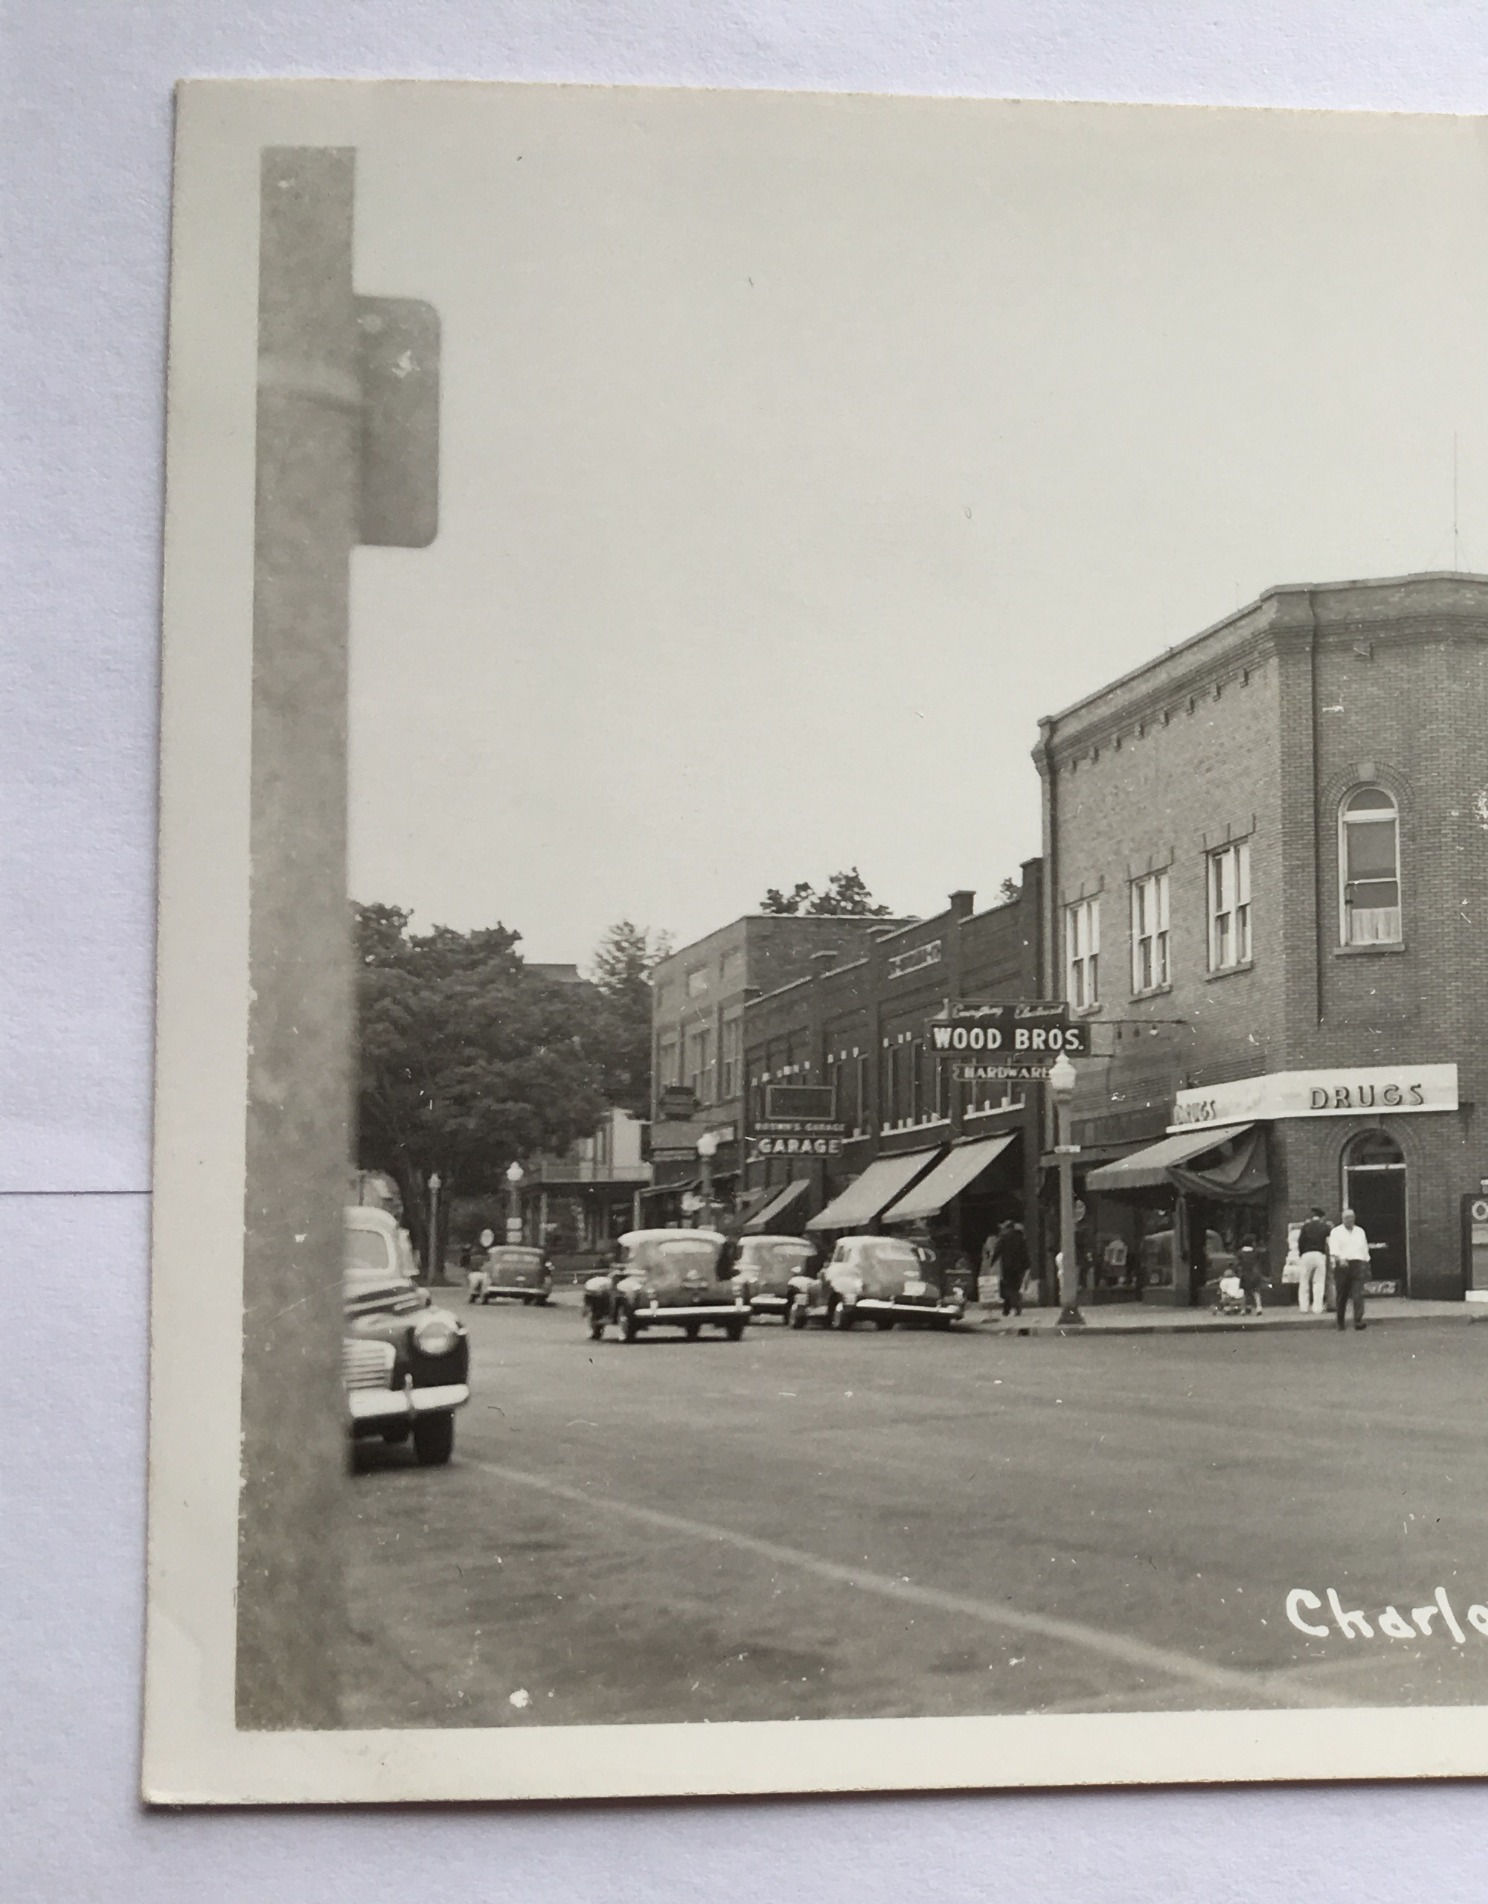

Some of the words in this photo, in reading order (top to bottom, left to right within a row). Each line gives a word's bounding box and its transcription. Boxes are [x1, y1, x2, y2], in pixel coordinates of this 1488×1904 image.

[933, 1028, 1002, 1049] WOOD
[1015, 1028, 1084, 1050] BROS.
[1310, 1083, 1425, 1110] DRUGS
[758, 1139, 840, 1153] GARAGE
